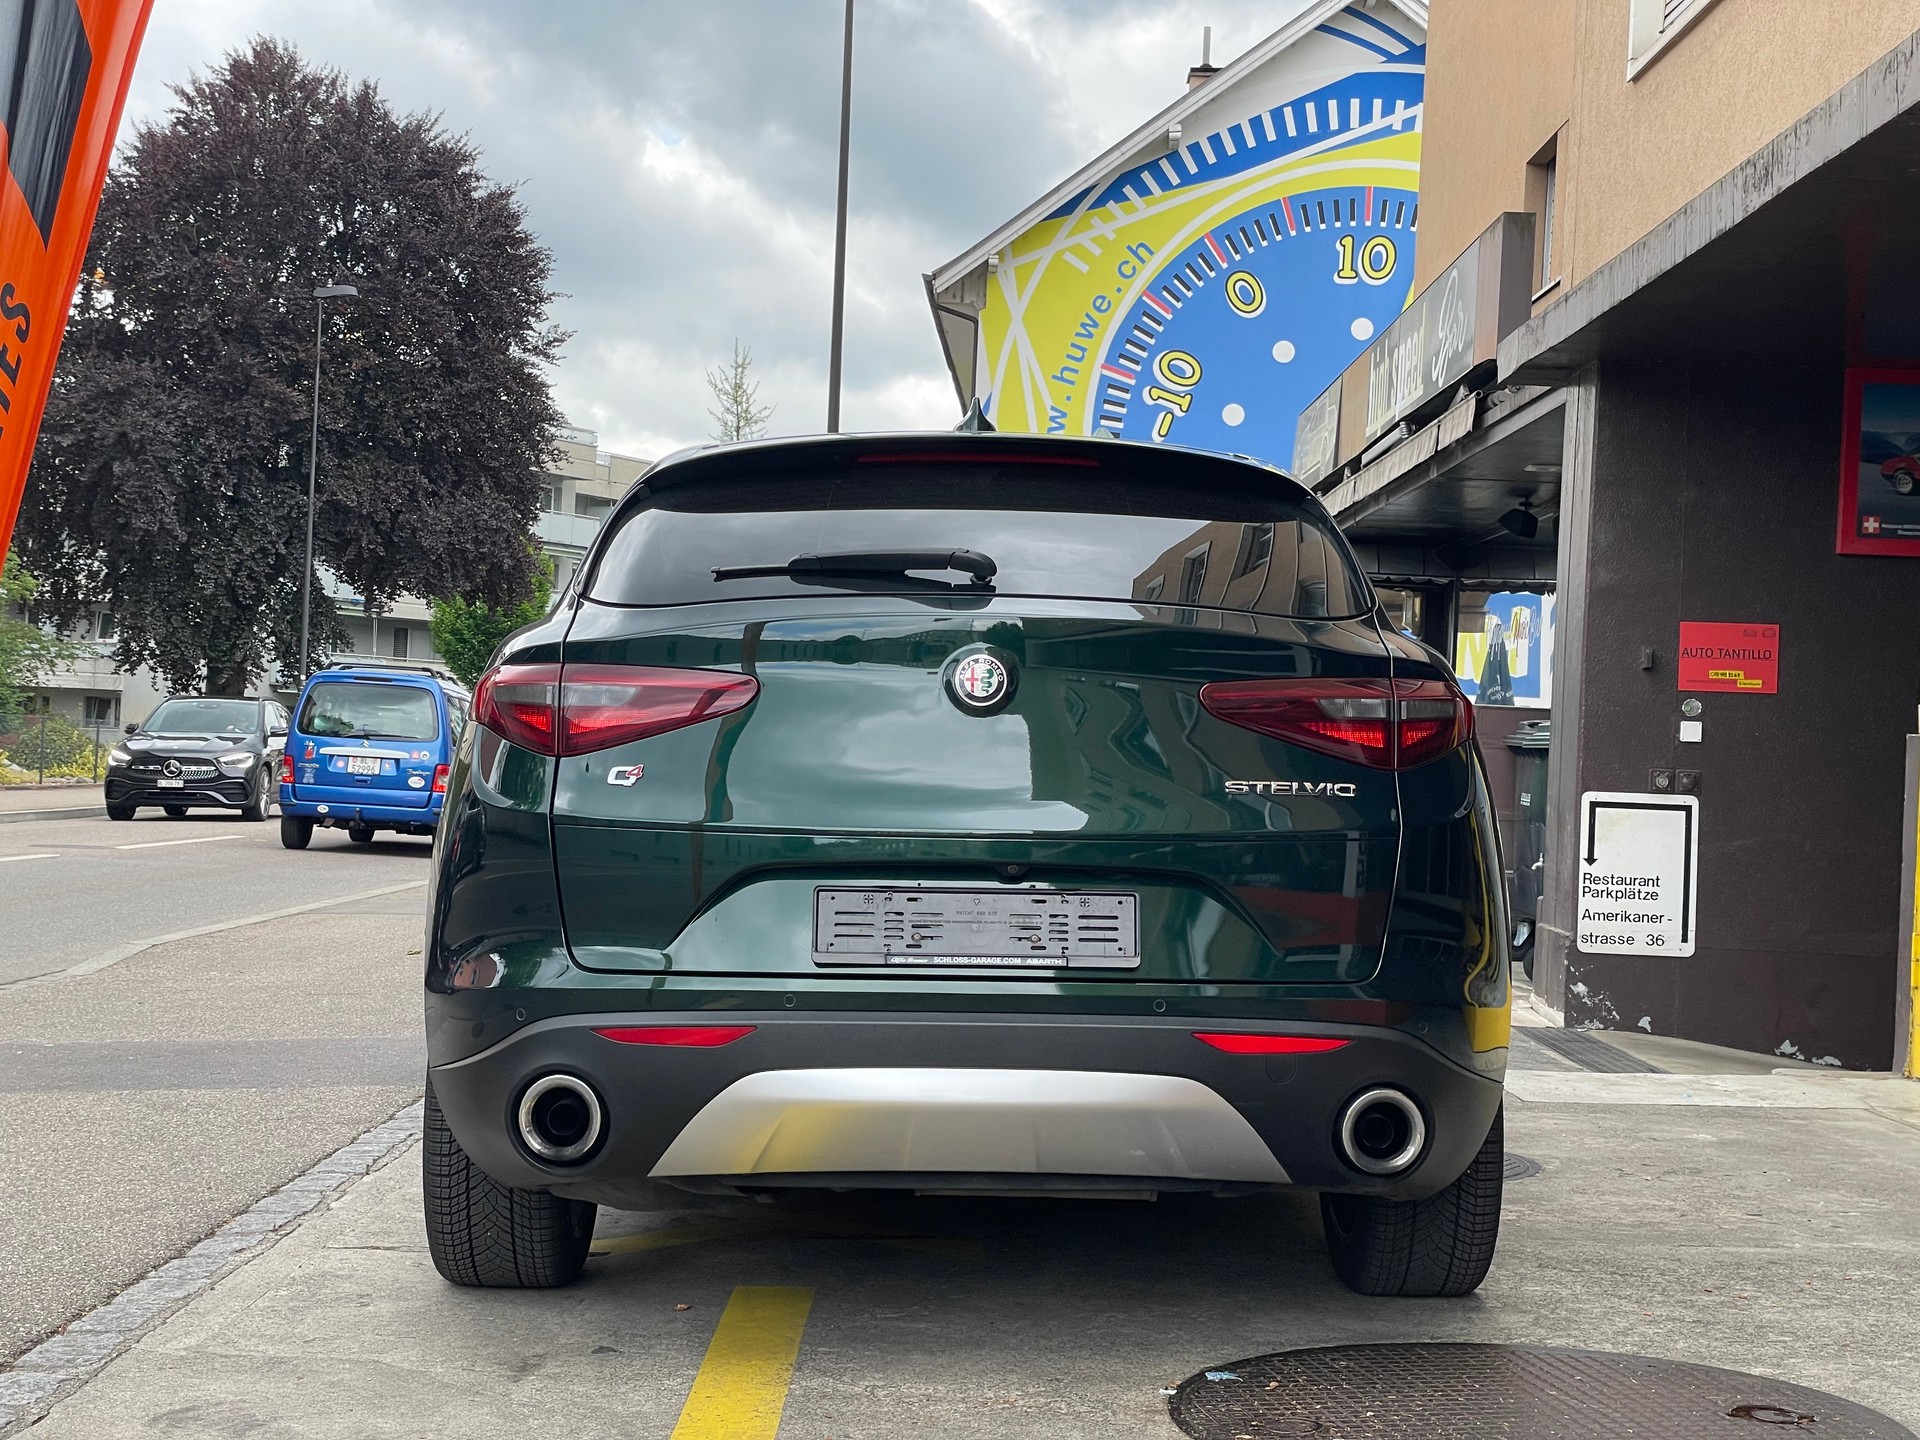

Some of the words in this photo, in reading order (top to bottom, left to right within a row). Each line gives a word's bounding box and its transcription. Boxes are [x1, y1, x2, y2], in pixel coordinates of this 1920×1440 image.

[1334, 234, 1398, 284] 10
[1224, 269, 1266, 317] 0
[1432, 268, 1468, 388] Bar
[1366, 338, 1390, 437] high
[1391, 302, 1426, 422] speed
[1147, 348, 1203, 440] -10
[1681, 647, 1714, 658] AUTO
[1717, 648, 1772, 660] TANTILLO
[960, 660, 976, 680] ALFA
[978, 658, 1004, 682] ROMEO
[351, 764, 376, 774] 52996
[607, 764, 645, 787] Q4
[1224, 780, 1357, 797] STELVIO
[1583, 872, 1661, 888] Restaurant
[1582, 885, 1659, 902] Parkplätze
[1580, 932, 1635, 945] strasse
[1645, 934, 1665, 947] 36
[933, 956, 1022, 965] SCHLOSS-GARAGE.COM
